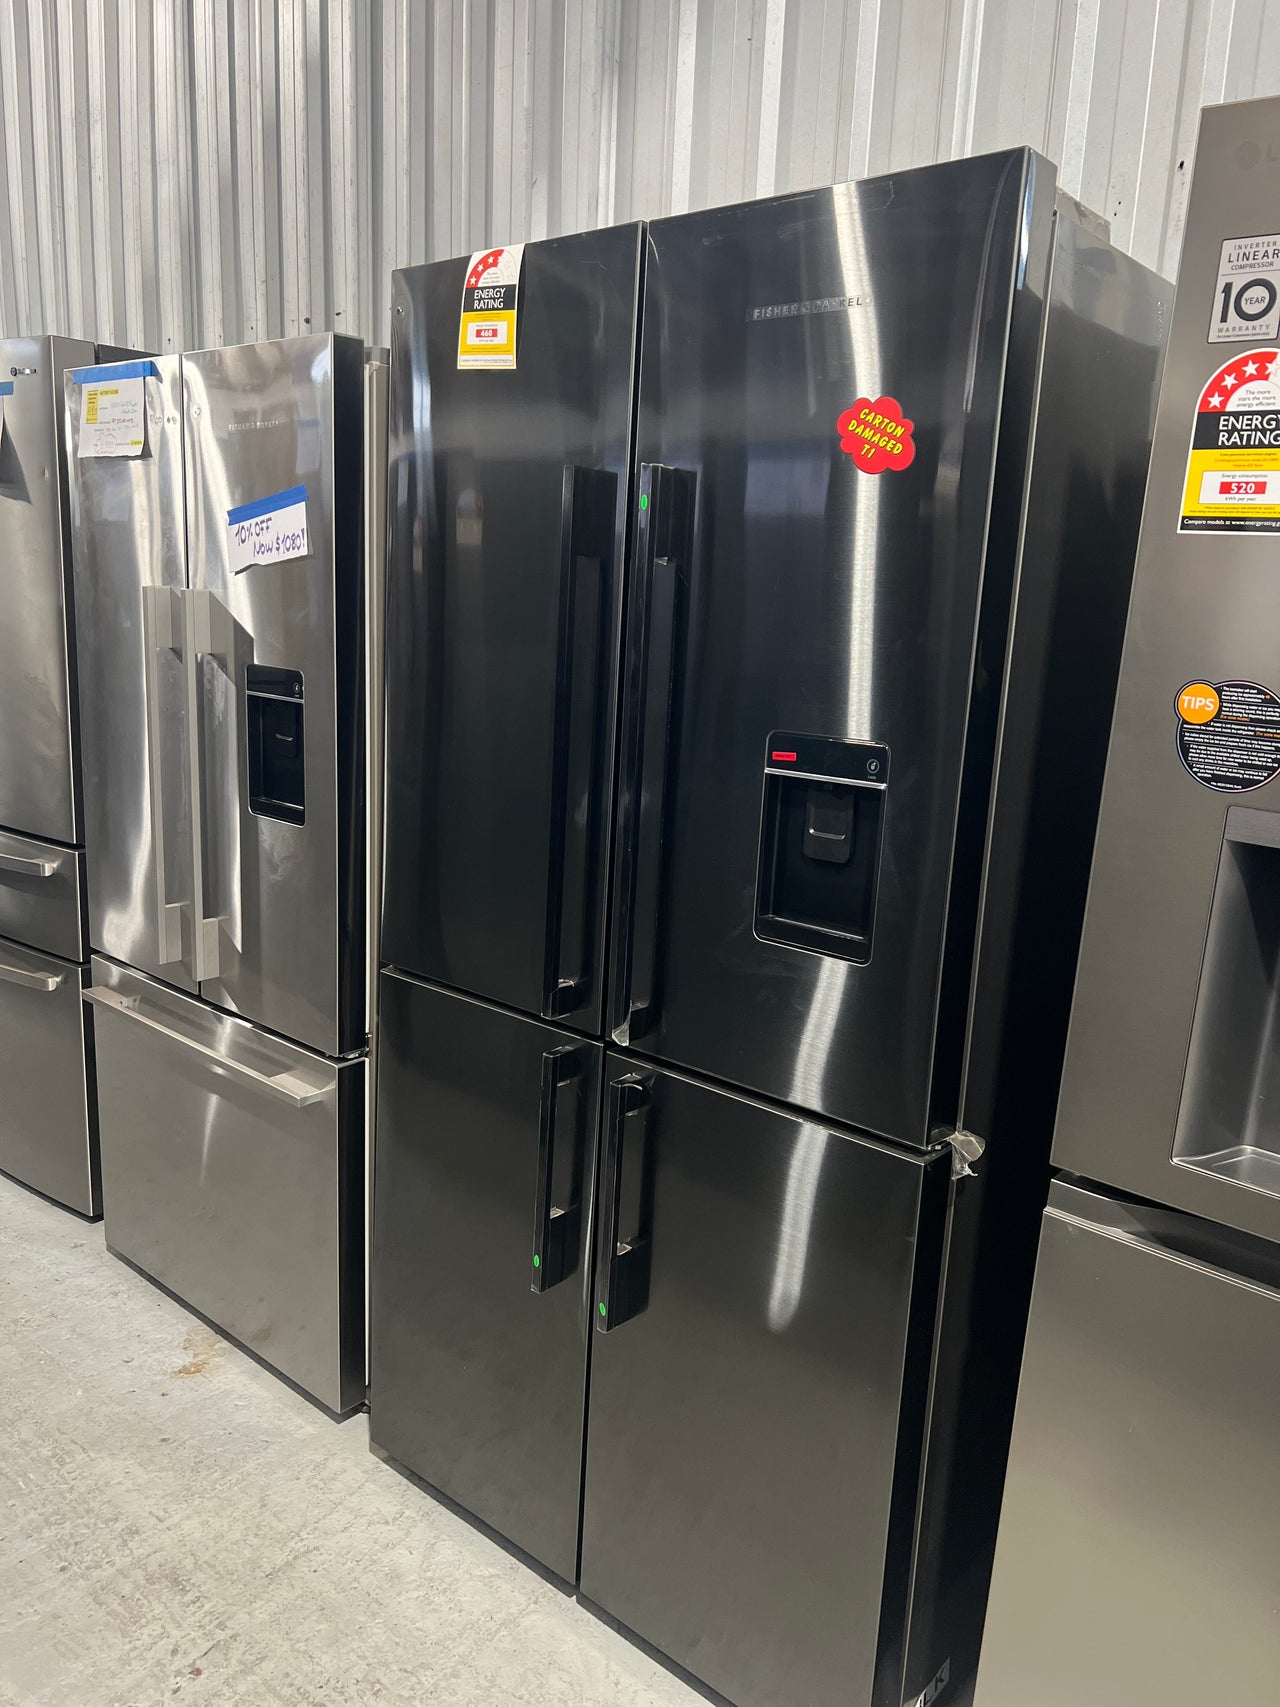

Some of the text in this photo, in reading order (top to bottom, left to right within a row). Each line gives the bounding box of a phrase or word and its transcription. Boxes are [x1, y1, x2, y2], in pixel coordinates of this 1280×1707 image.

[1233, 241, 1277, 250] INVERTER
[1228, 248, 1280, 263] LINEAR
[1231, 261, 1274, 271] COMPRESSOR
[474, 287, 506, 299] ENERGY
[473, 299, 504, 310] RATING
[1219, 278, 1277, 323] 10
[1244, 296, 1266, 305] YEAR
[752, 303, 798, 320] FISHER
[814, 297, 862, 312] PAKEL
[480, 329, 493, 337] 460
[1217, 323, 1271, 334] WARRANTY
[860, 408, 905, 438] CARTON
[1219, 414, 1280, 430] ENERG
[848, 419, 903, 455] DAMAGED
[1230, 482, 1256, 494] 520
[235, 516, 273, 546] 10% OFF
[1182, 695, 1215, 711] TIPS
